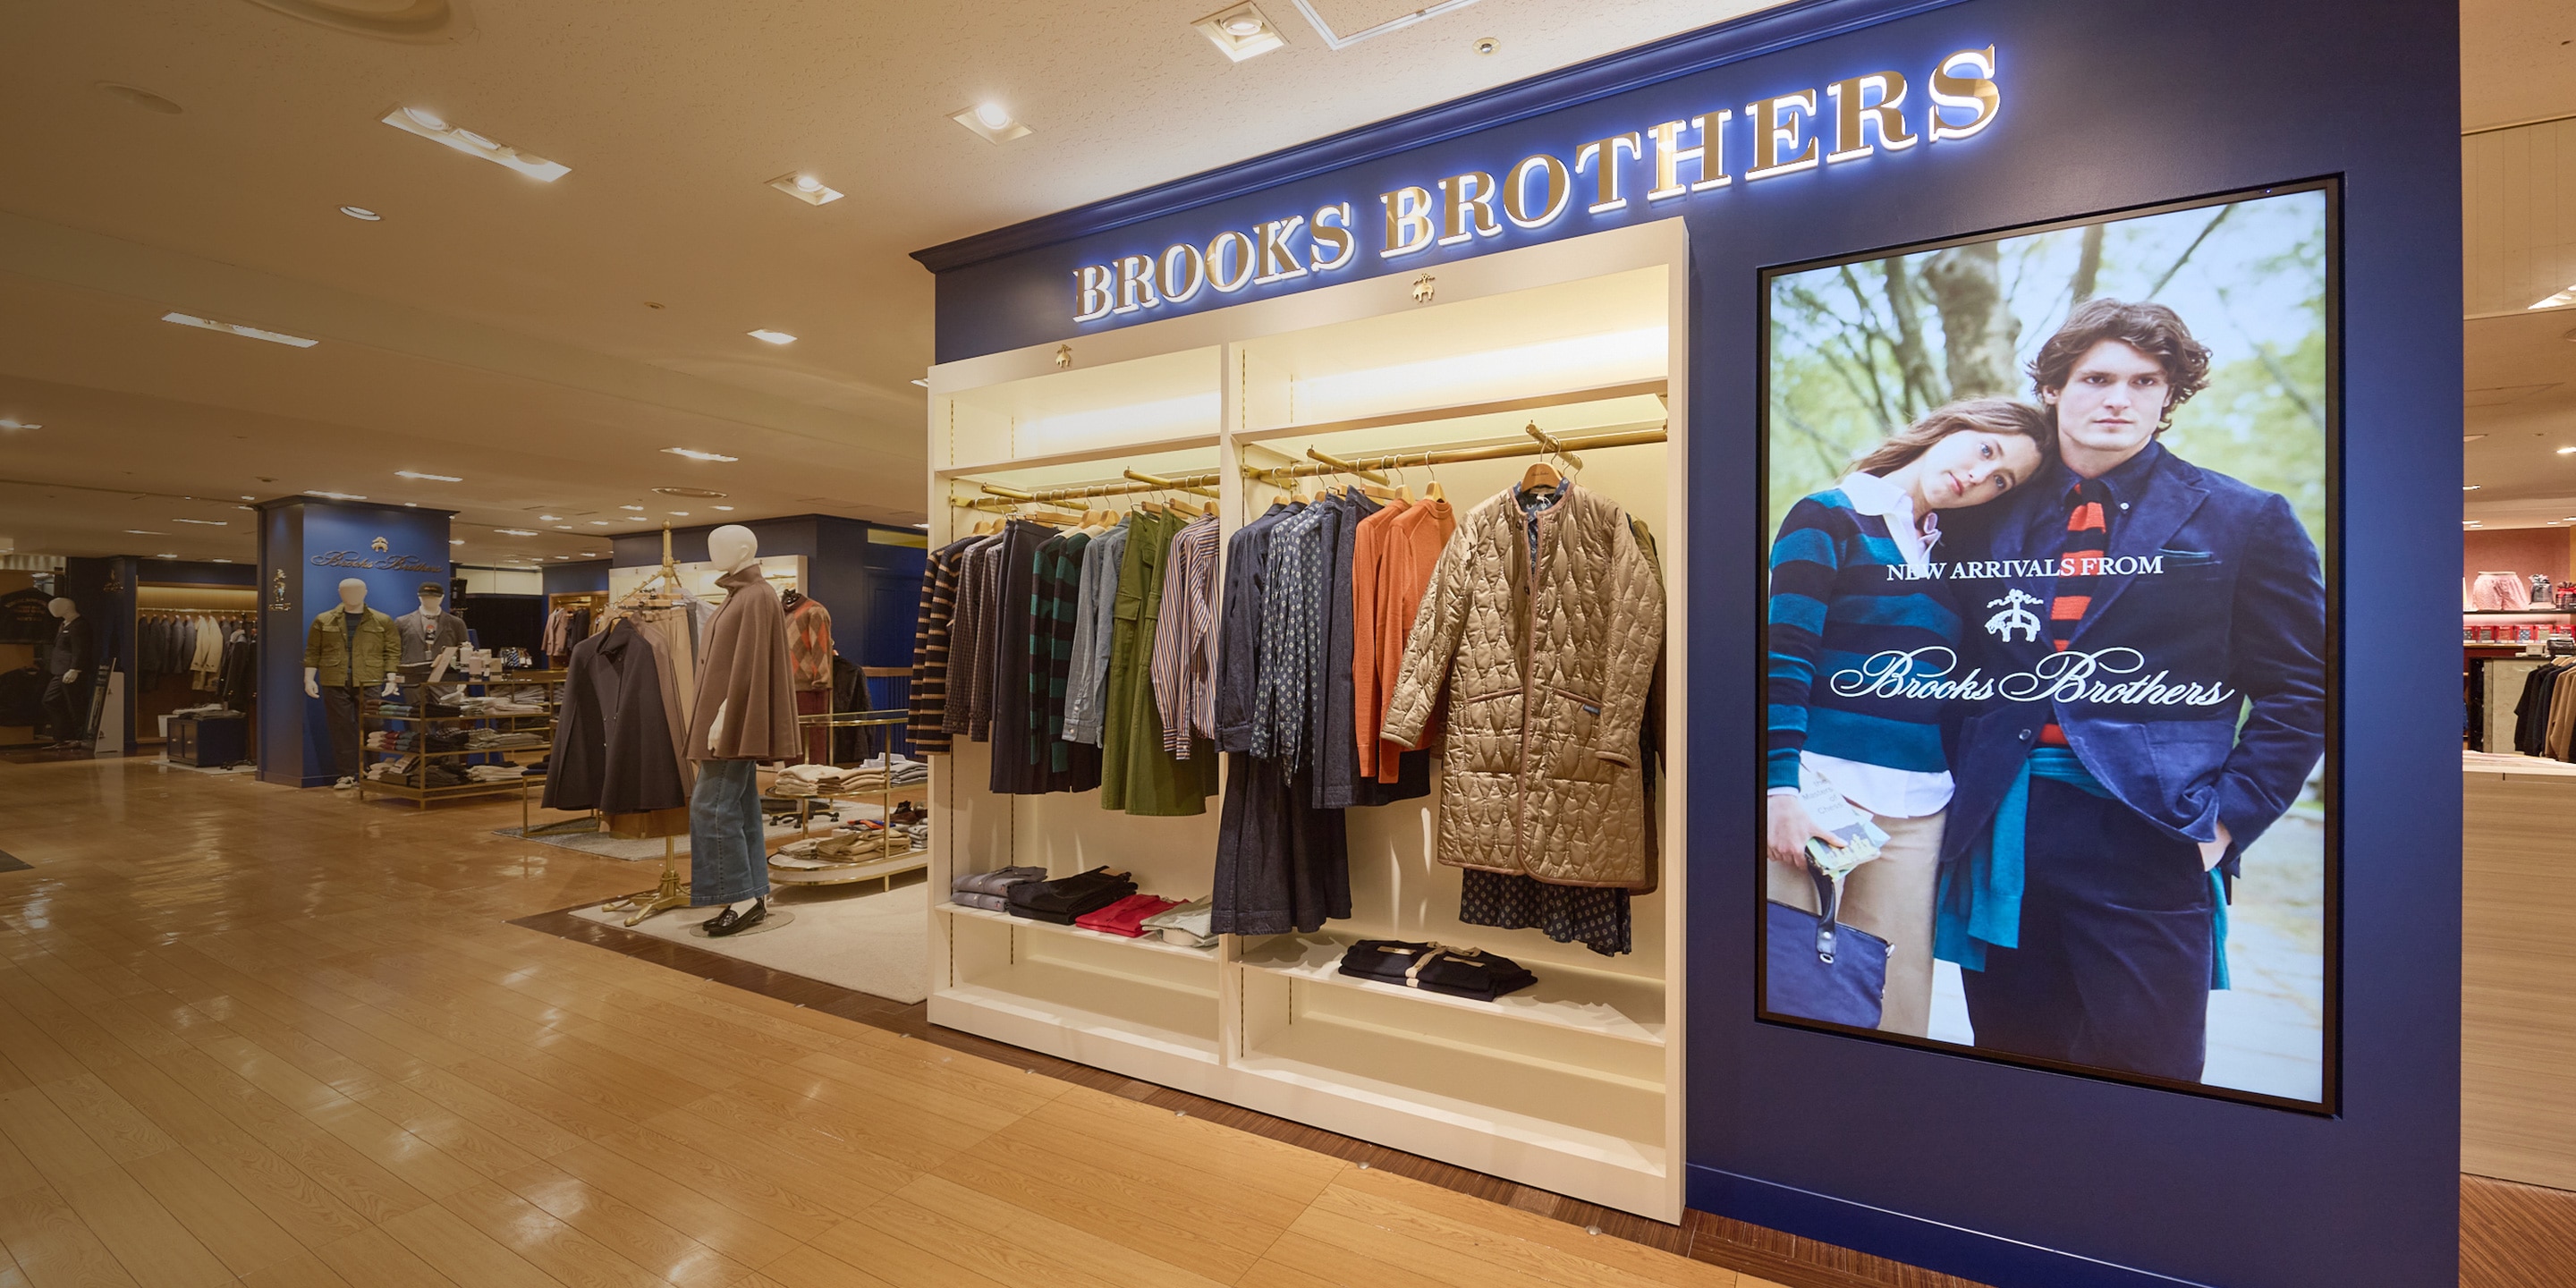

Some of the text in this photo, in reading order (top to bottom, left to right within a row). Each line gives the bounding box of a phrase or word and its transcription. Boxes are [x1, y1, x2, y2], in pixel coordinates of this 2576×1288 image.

[1072, 44, 2001, 323] BROOKS BROTHERS
[1886, 555, 2164, 580] NEW ARRIVALS FROM
[1830, 646, 2235, 706] Brooks Brothers
